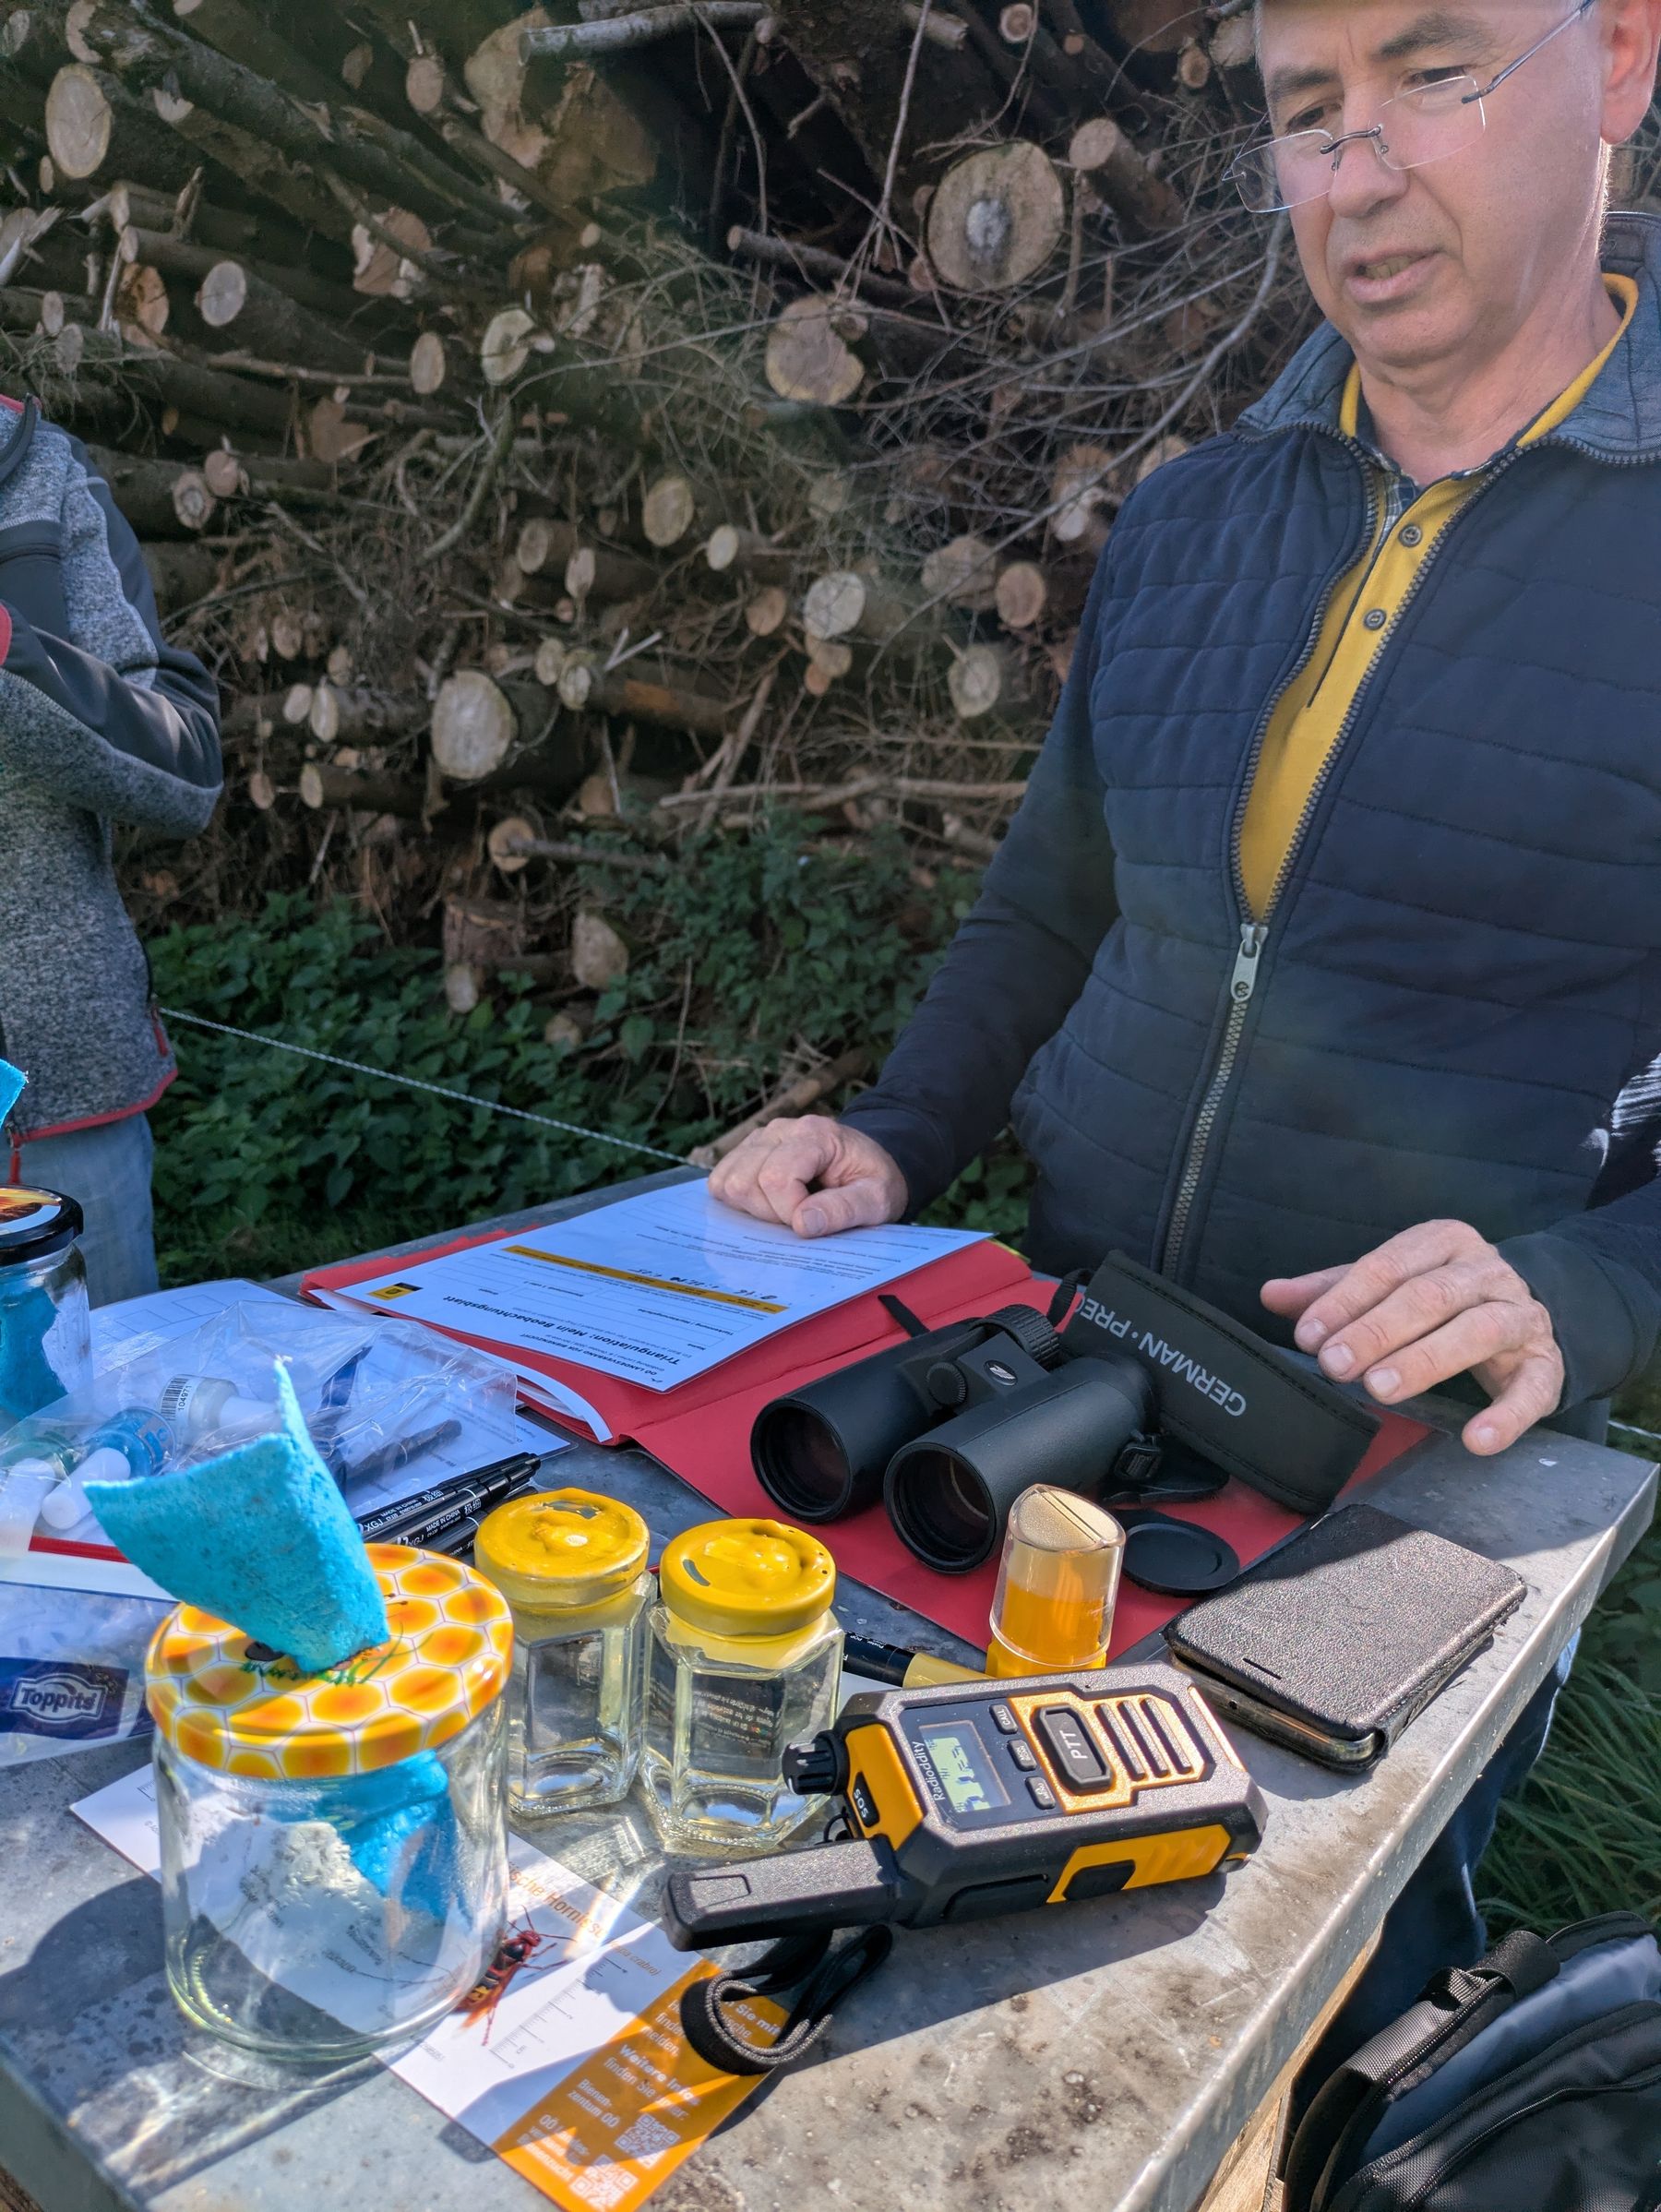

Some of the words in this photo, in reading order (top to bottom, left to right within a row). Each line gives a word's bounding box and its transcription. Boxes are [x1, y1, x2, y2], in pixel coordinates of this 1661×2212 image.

[443, 1296, 556, 1328] Beobachtungsblatt
[556, 1325, 588, 1337] Mein
[591, 1333, 680, 1366] Triangulation:
[1138, 1332, 1246, 1417] GERMAN
[177, 1385, 192, 1411] 104971
[364, 1519, 383, 1532] XGJ
[426, 1520, 440, 1532] MADE
[446, 1510, 460, 1521] CHINA
[21, 1687, 95, 1713] Toppits
[998, 1709, 1010, 1725] CALL
[1059, 1730, 1088, 1760] PTT
[912, 1741, 946, 1800] Radioddity
[853, 1788, 868, 1819] SOS
[1038, 1782, 1050, 1799] MENU
[735, 2002, 759, 2021] Sie
[639, 2024, 683, 2057] melden.
[603, 2056, 640, 2085] finden
[636, 2080, 657, 2098] Sie
[617, 2043, 670, 2083] Weitere
[665, 2076, 703, 2107] Infos
[577, 2078, 615, 2108] Bienen-
